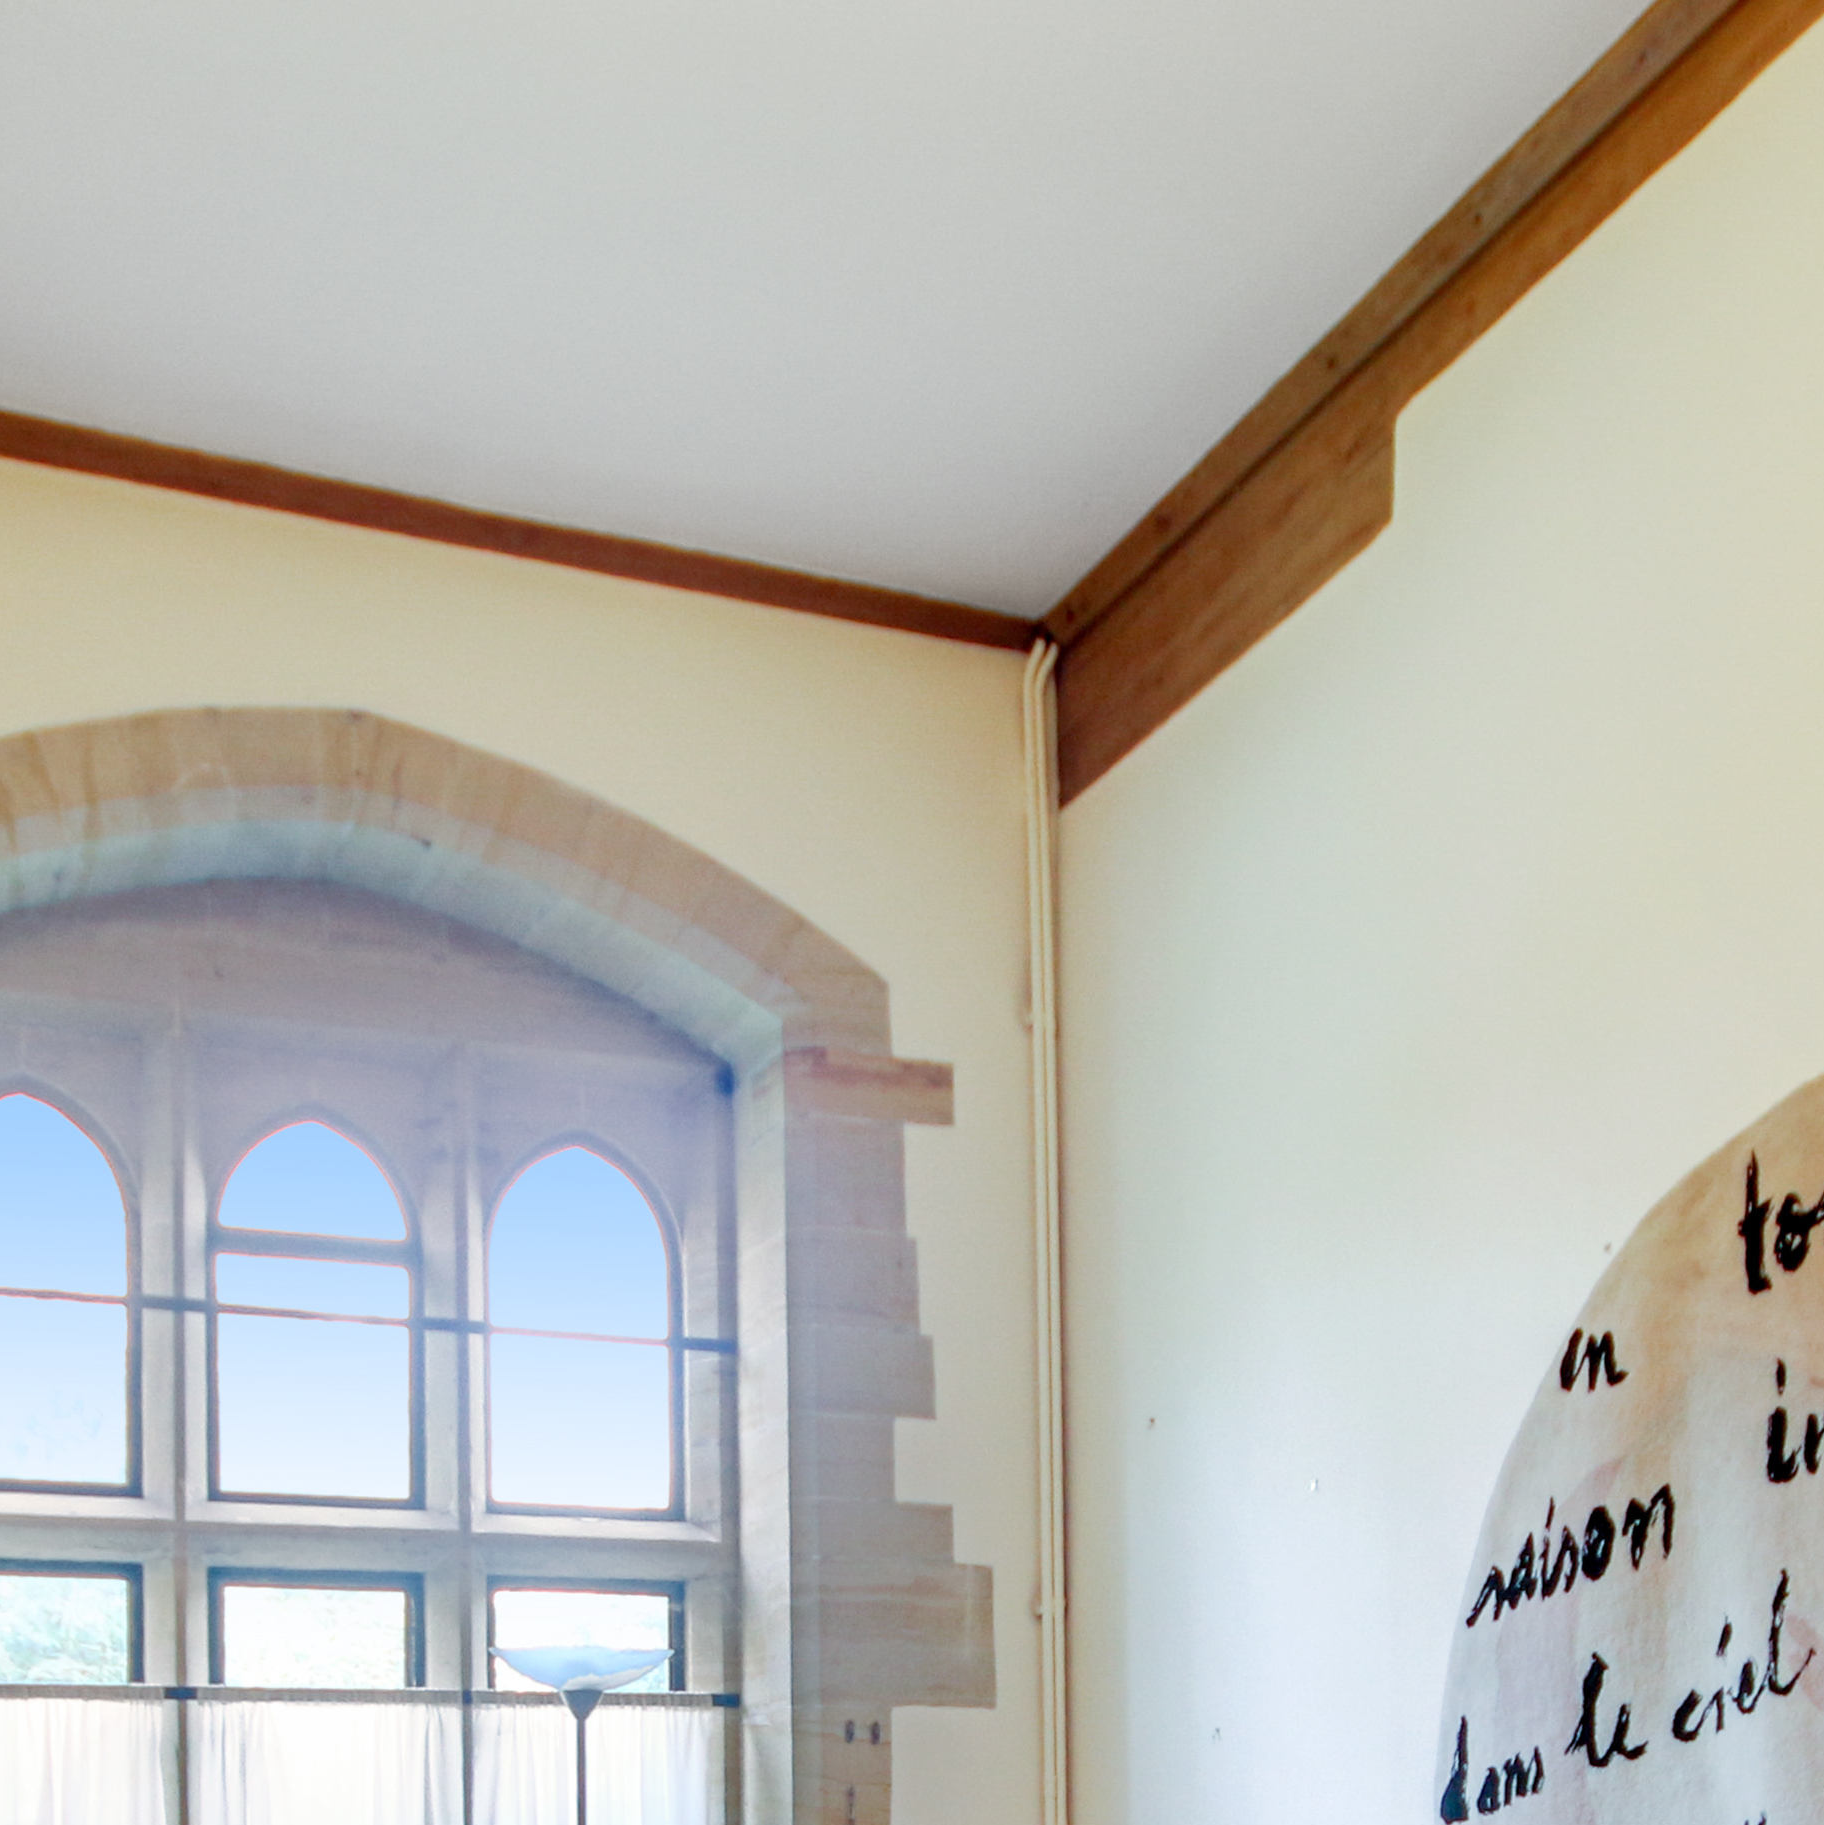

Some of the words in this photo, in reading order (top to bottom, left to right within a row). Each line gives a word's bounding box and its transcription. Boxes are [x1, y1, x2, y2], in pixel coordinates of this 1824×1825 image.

[1465, 1482, 1677, 1628] saison
[1439, 1716, 1545, 1825] dans
[1563, 1651, 1649, 1769] le
[1670, 1565, 1817, 1744] ciel
